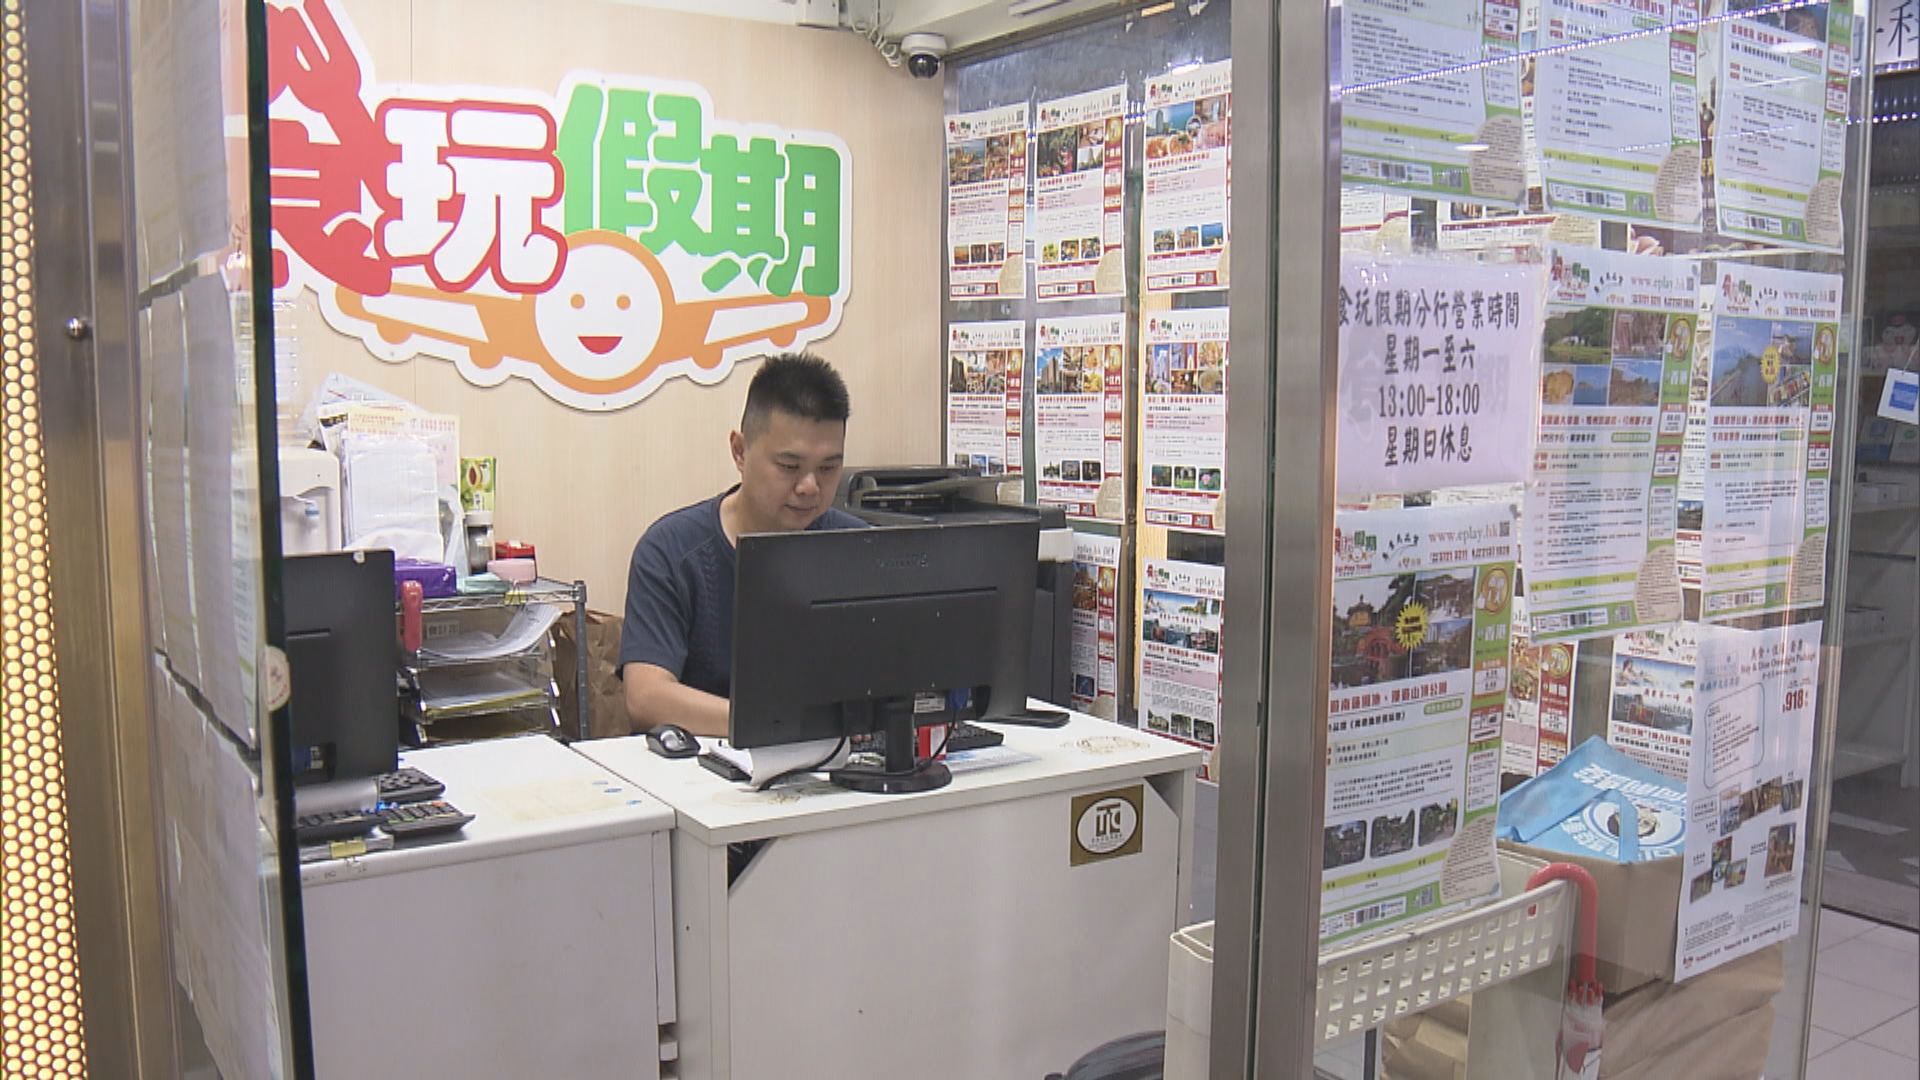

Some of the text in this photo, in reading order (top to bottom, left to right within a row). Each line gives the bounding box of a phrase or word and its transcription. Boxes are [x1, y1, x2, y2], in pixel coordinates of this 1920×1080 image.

[1384, 334, 1476, 375] 星期一至六
[1379, 383, 1480, 417] 13:00-18:00
[1384, 423, 1473, 467] 星期日休息
